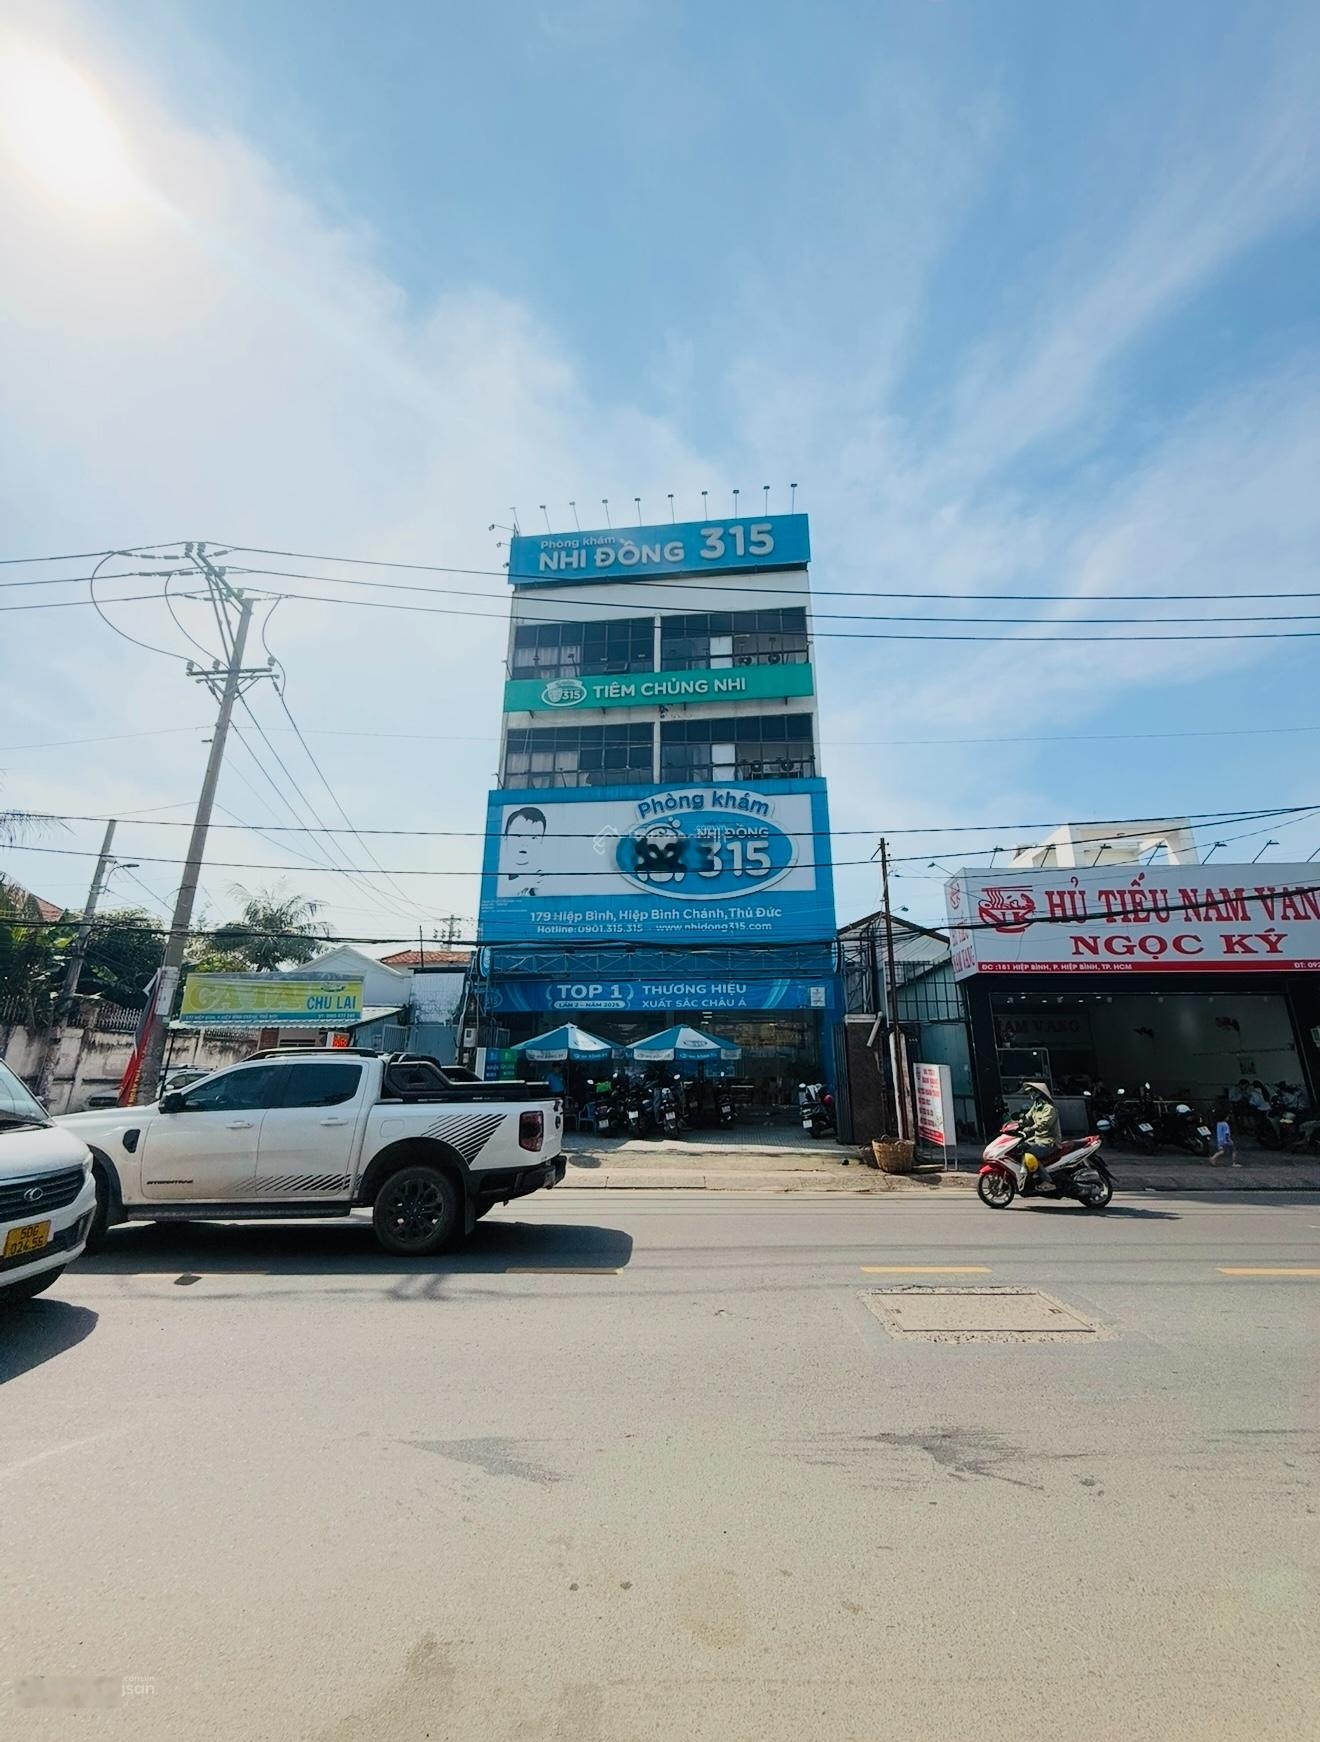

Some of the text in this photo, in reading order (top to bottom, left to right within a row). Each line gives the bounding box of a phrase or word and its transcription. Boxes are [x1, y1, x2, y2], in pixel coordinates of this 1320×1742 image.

[540, 535, 615, 551] Phòng khám
[540, 523, 775, 571] NHI ĐỒNG 315
[594, 683, 635, 699] TIÊM
[641, 678, 709, 696] CHỦNG
[714, 677, 746, 692] NHI
[637, 791, 769, 819] Phòng khám
[1045, 876, 1088, 924] HỦ
[1098, 872, 1172, 923] TIẾU
[1182, 887, 1252, 922] NAM
[530, 911, 551, 922] 179
[554, 910, 583, 924] Hiệp
[586, 909, 616, 922] Bình,
[619, 909, 649, 923] Hiệp
[651, 908, 680, 920] Bình
[755, 906, 783, 918] Đức
[1070, 928, 1289, 960] NGỌC KÝ
[556, 984, 623, 999] TOP 1
[642, 981, 747, 996] THƯƠNG HIỆU
[306, 995, 357, 1010] CHU LAI
[642, 997, 671, 1008] XUẤT
